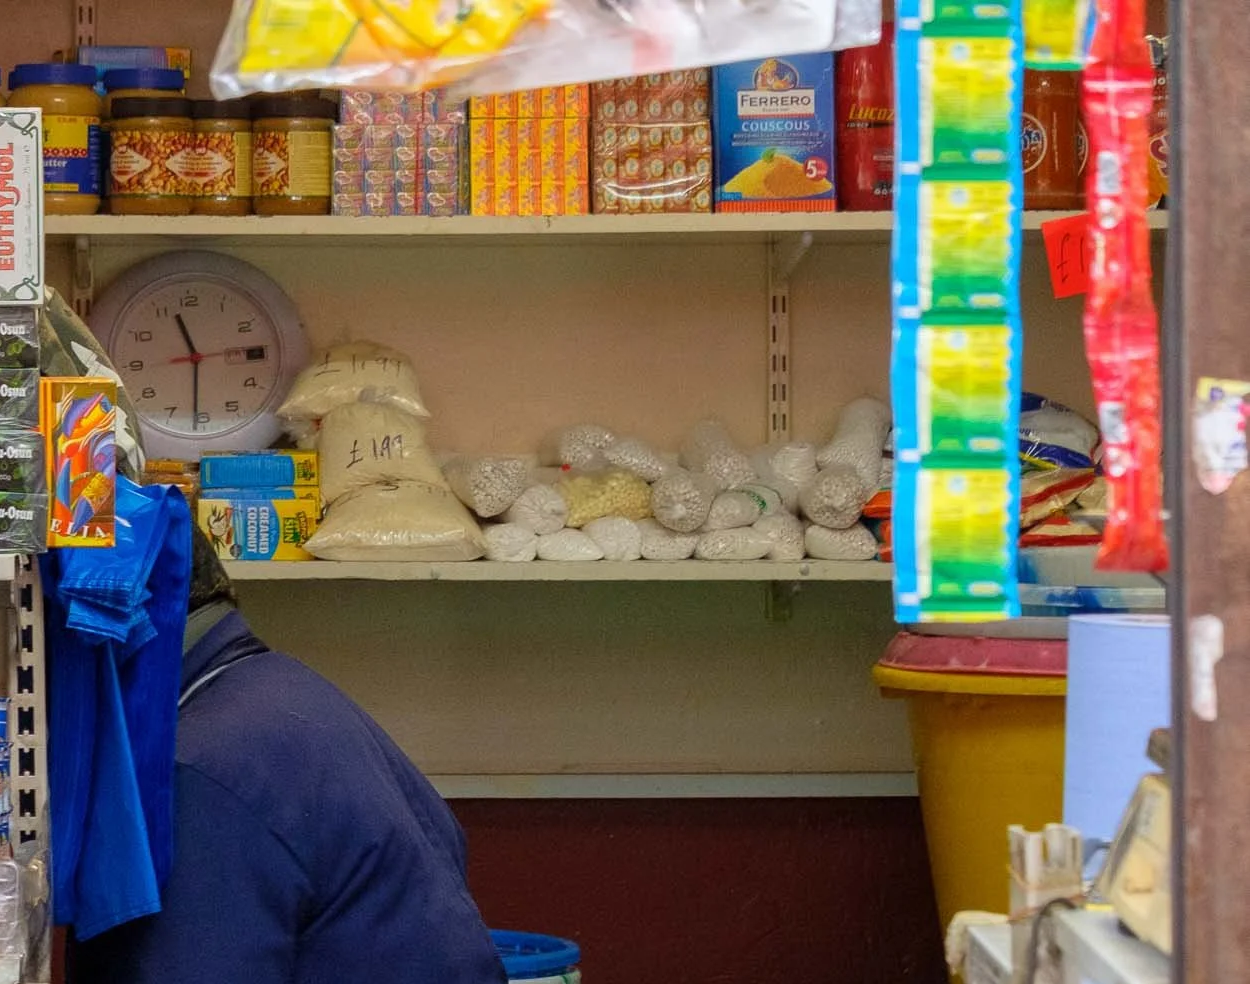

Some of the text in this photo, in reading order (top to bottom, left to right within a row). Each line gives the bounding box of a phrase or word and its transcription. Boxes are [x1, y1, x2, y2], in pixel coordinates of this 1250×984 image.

[740, 94, 811, 108] FERRERO
[742, 120, 810, 132] COUSCOUS
[806, 160, 818, 179] 5
[180, 296, 199, 307] 12
[156, 307, 168, 318] 11
[237, 321, 251, 333] 2
[133, 331, 152, 342] 10
[128, 360, 143, 371] 9
[244, 377, 257, 388] 4
[142, 387, 156, 398] 8
[225, 401, 238, 412] 5
[164, 407, 177, 419] 7
[247, 506, 257, 553] COCONUT
[259, 506, 269, 554] CREAMED
[284, 517, 294, 543] SUN
